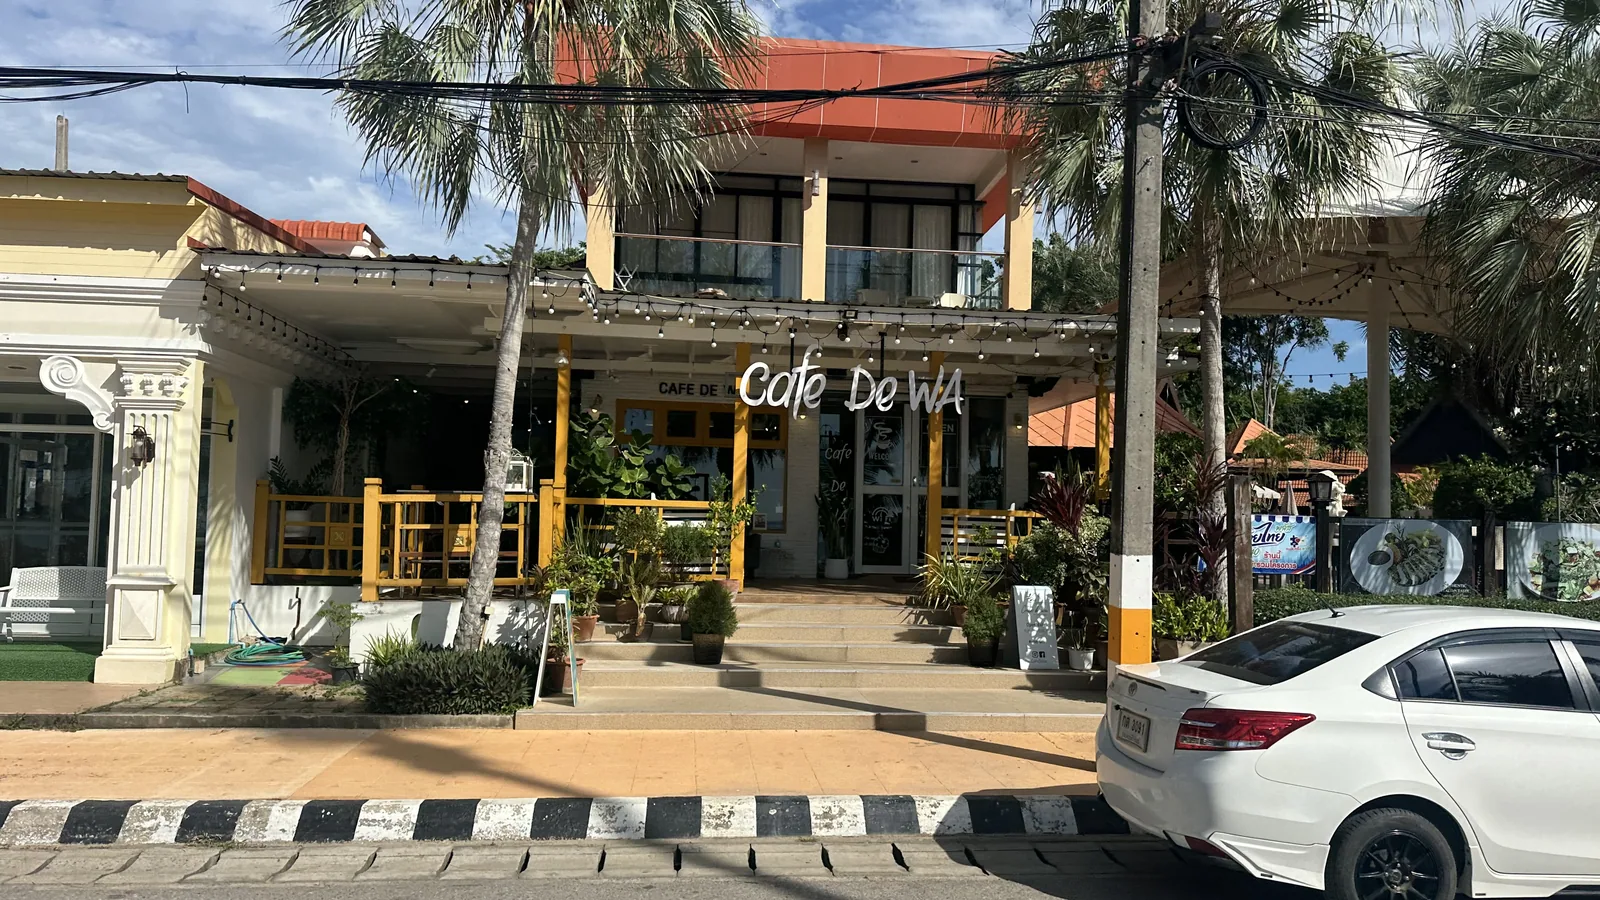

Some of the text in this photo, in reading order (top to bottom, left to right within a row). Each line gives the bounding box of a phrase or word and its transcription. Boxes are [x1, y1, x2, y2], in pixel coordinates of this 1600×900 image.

[659, 382, 695, 395] CAFE
[700, 383, 718, 397] DE
[739, 343, 964, 420] Cafe De WA
[824, 443, 852, 465] Cafe
[831, 479, 846, 492] De
